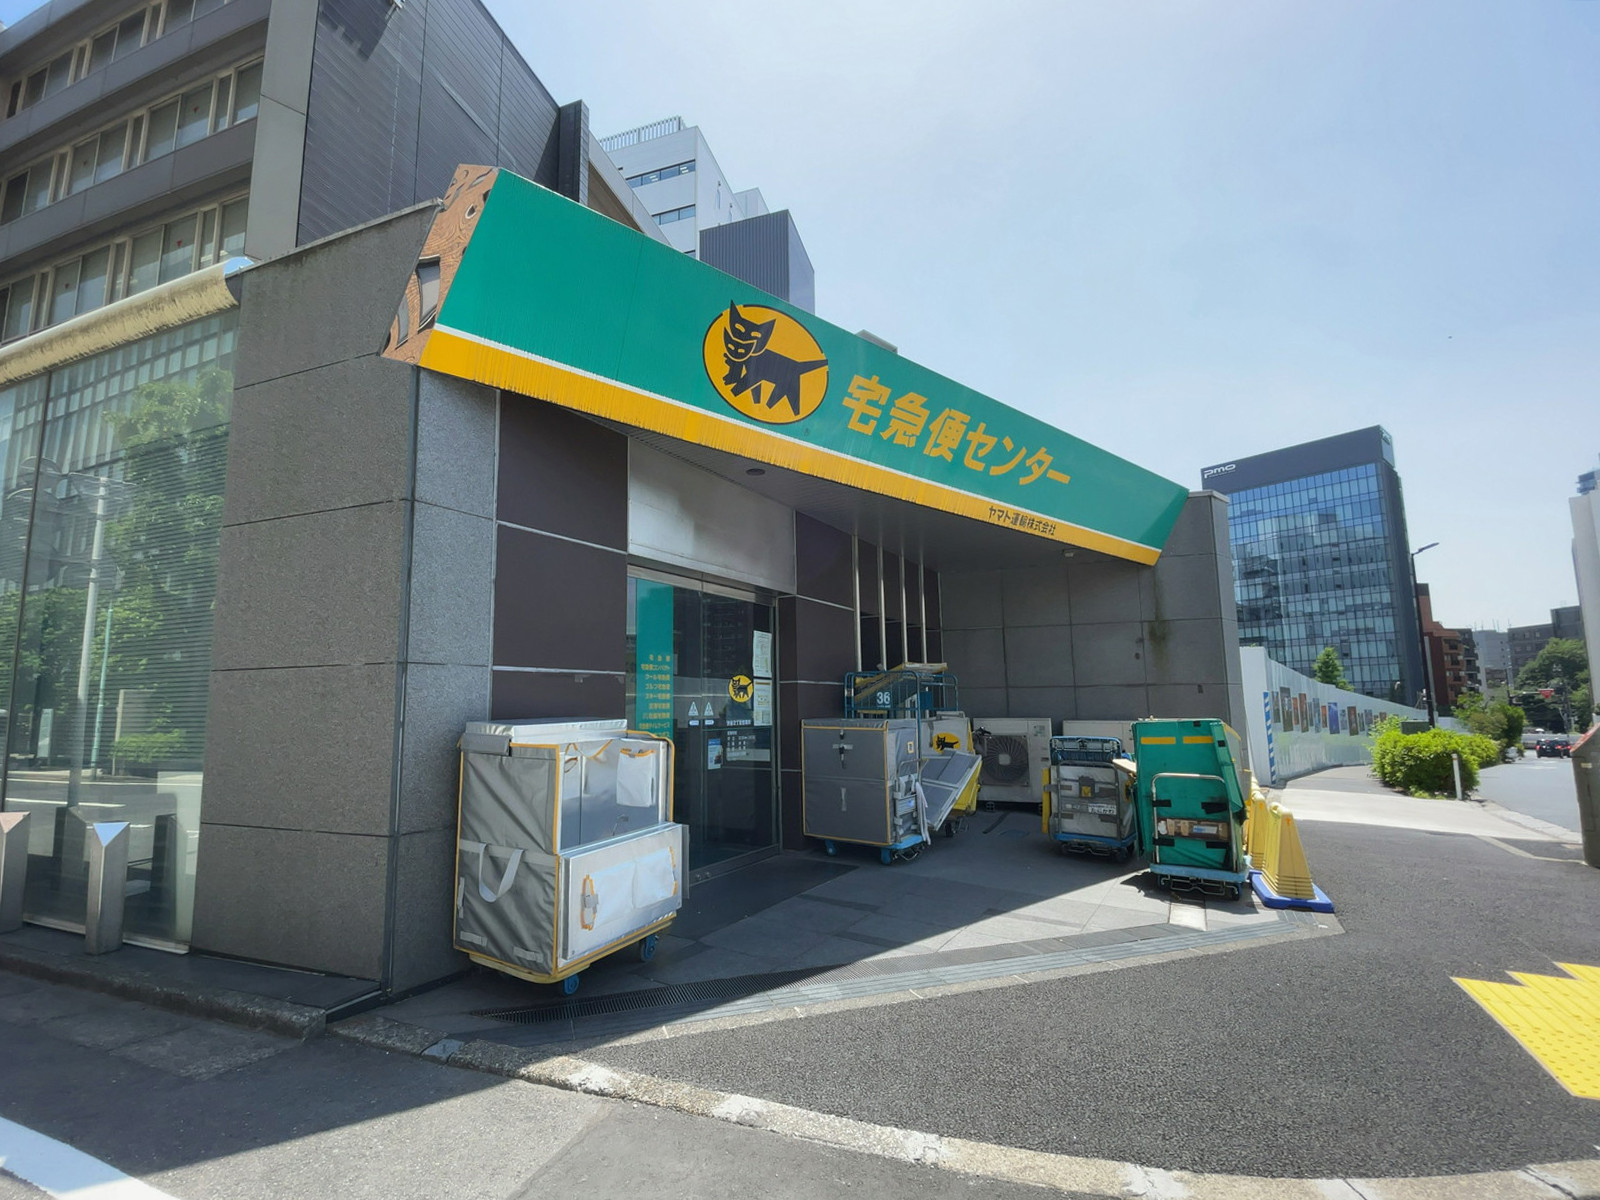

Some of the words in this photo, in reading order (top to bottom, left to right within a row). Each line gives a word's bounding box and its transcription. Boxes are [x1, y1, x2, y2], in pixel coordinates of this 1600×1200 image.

[842, 374, 1071, 486] 宅急便センター
[988, 505, 1057, 536] ヤマト運輸株式会社
[876, 691, 891, 705] 36
